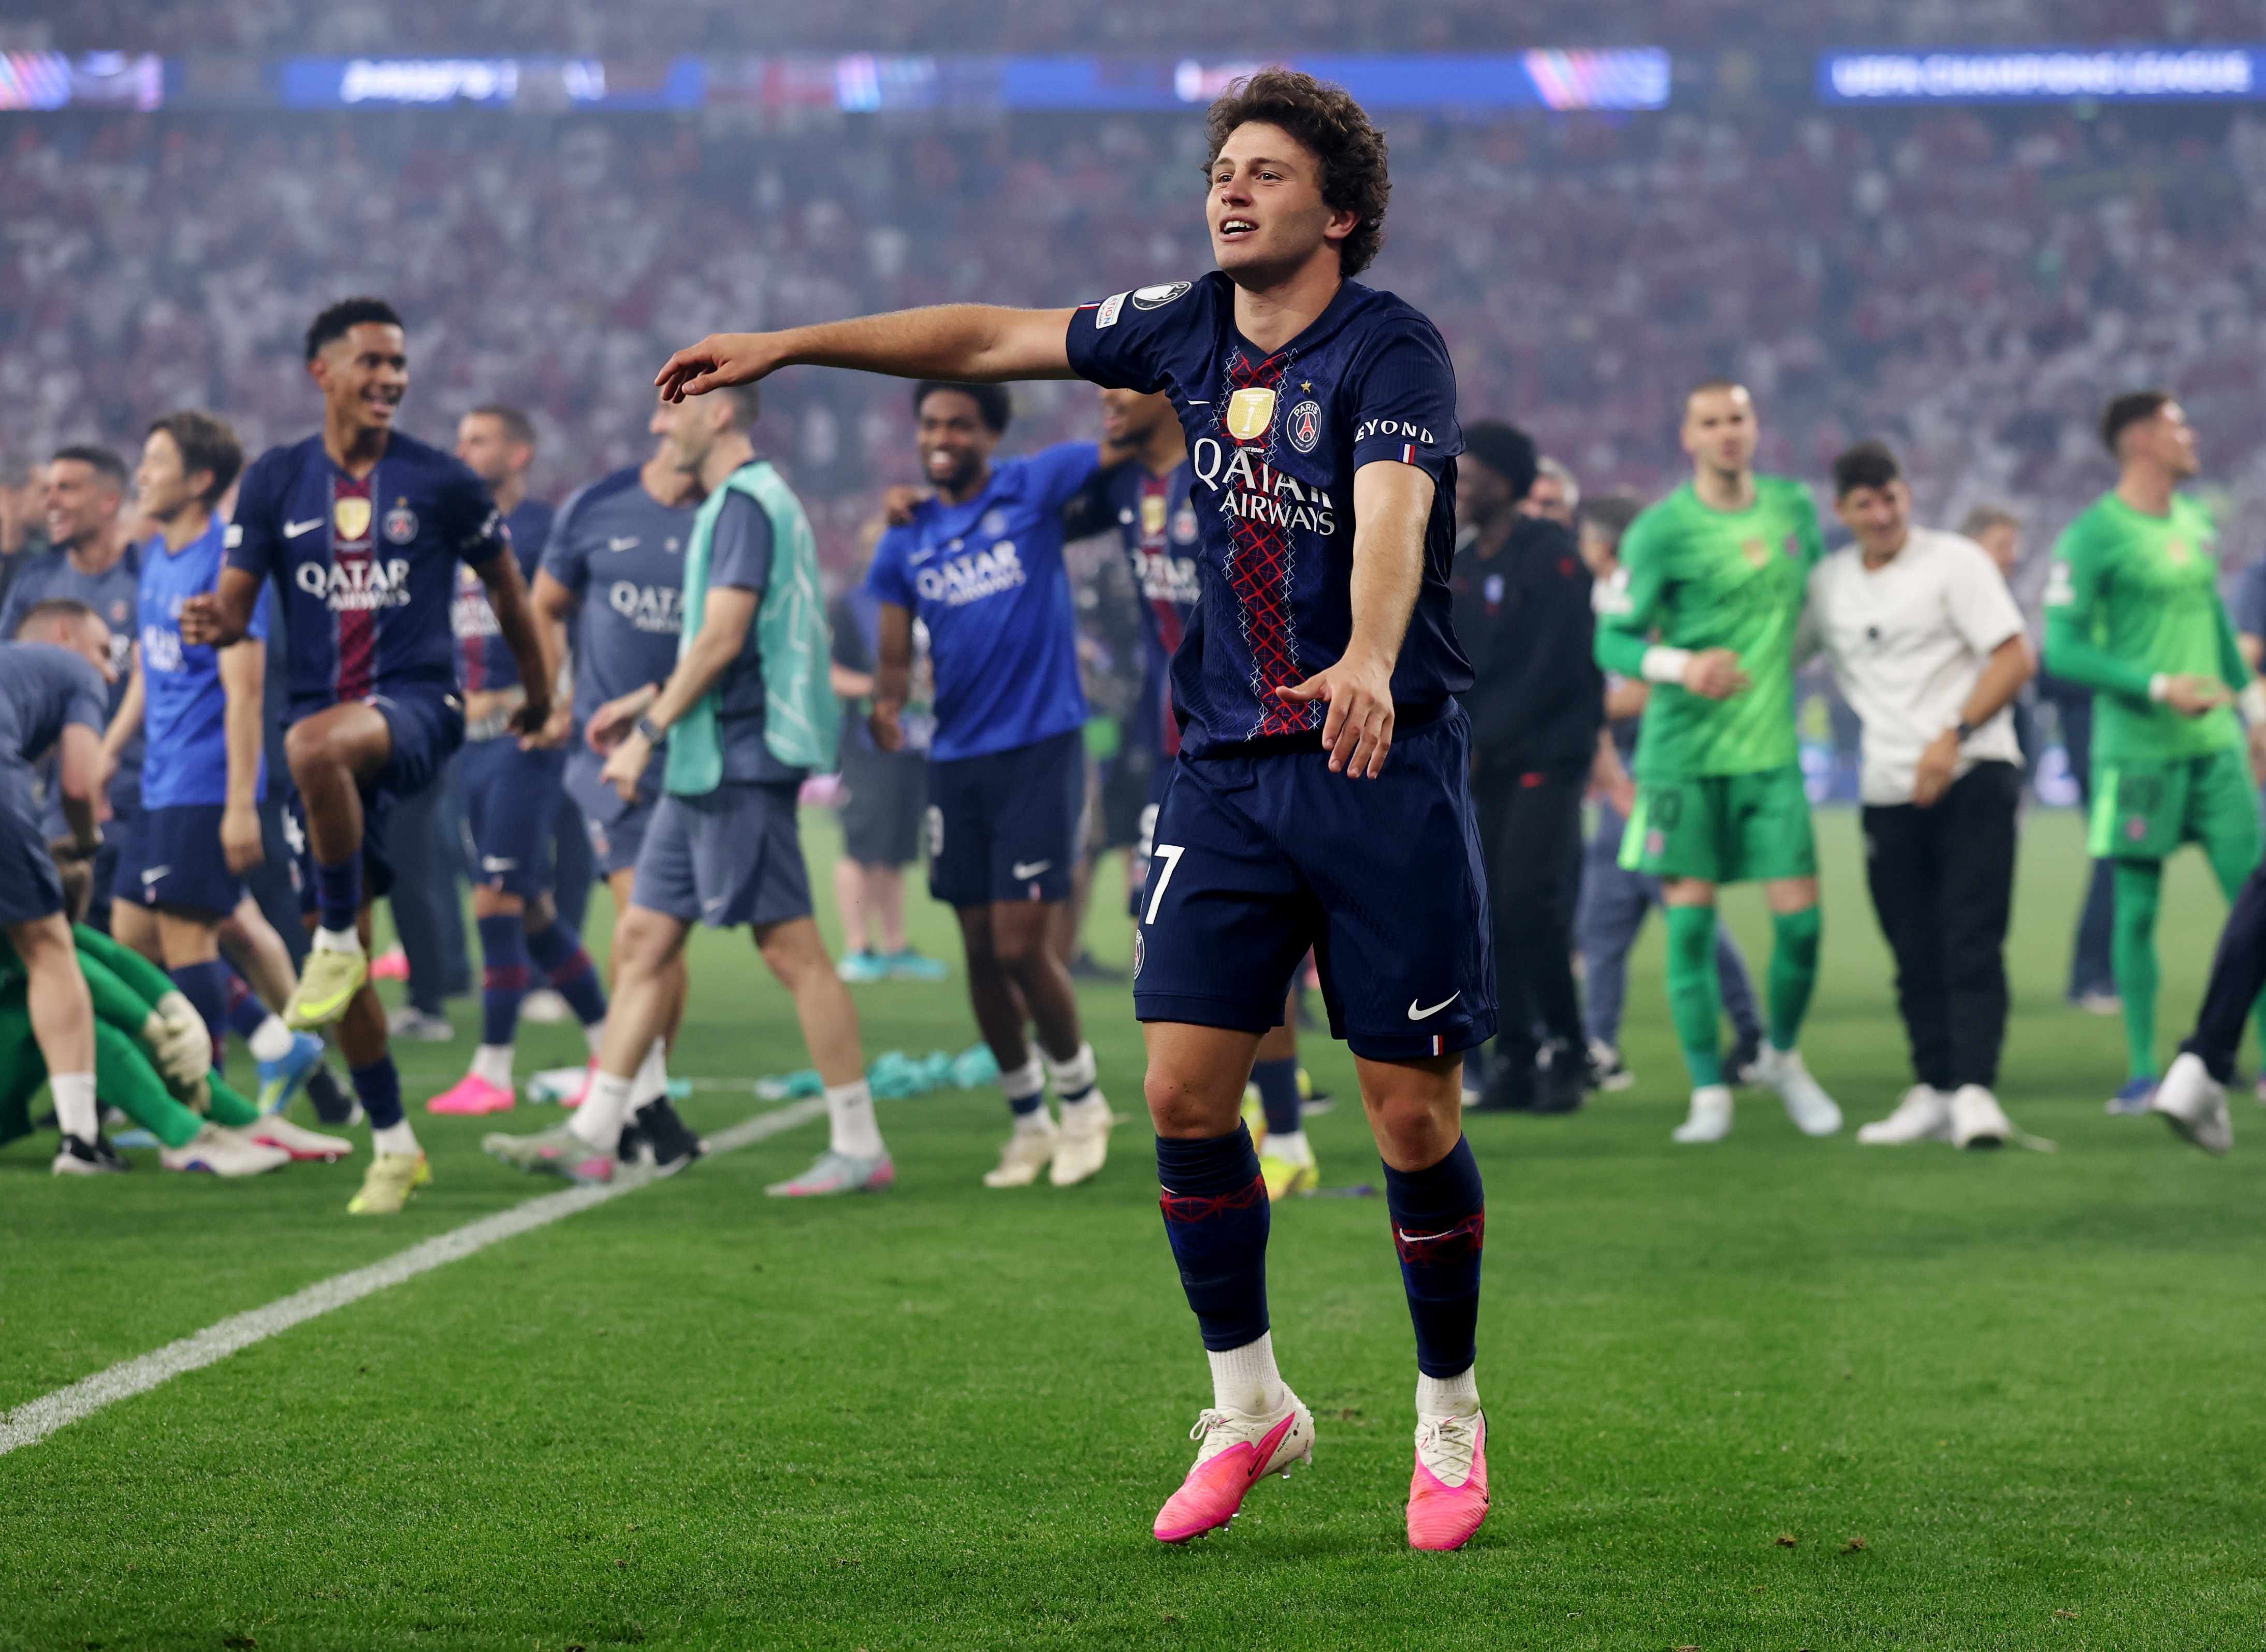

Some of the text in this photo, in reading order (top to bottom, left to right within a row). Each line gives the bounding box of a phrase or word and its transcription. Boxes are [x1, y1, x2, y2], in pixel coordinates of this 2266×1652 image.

[1294, 403, 1318, 417] PARIS
[1218, 490, 1335, 535] AIRWAYS
[296, 558, 410, 600] QATAR
[1141, 844, 1185, 925] 7
